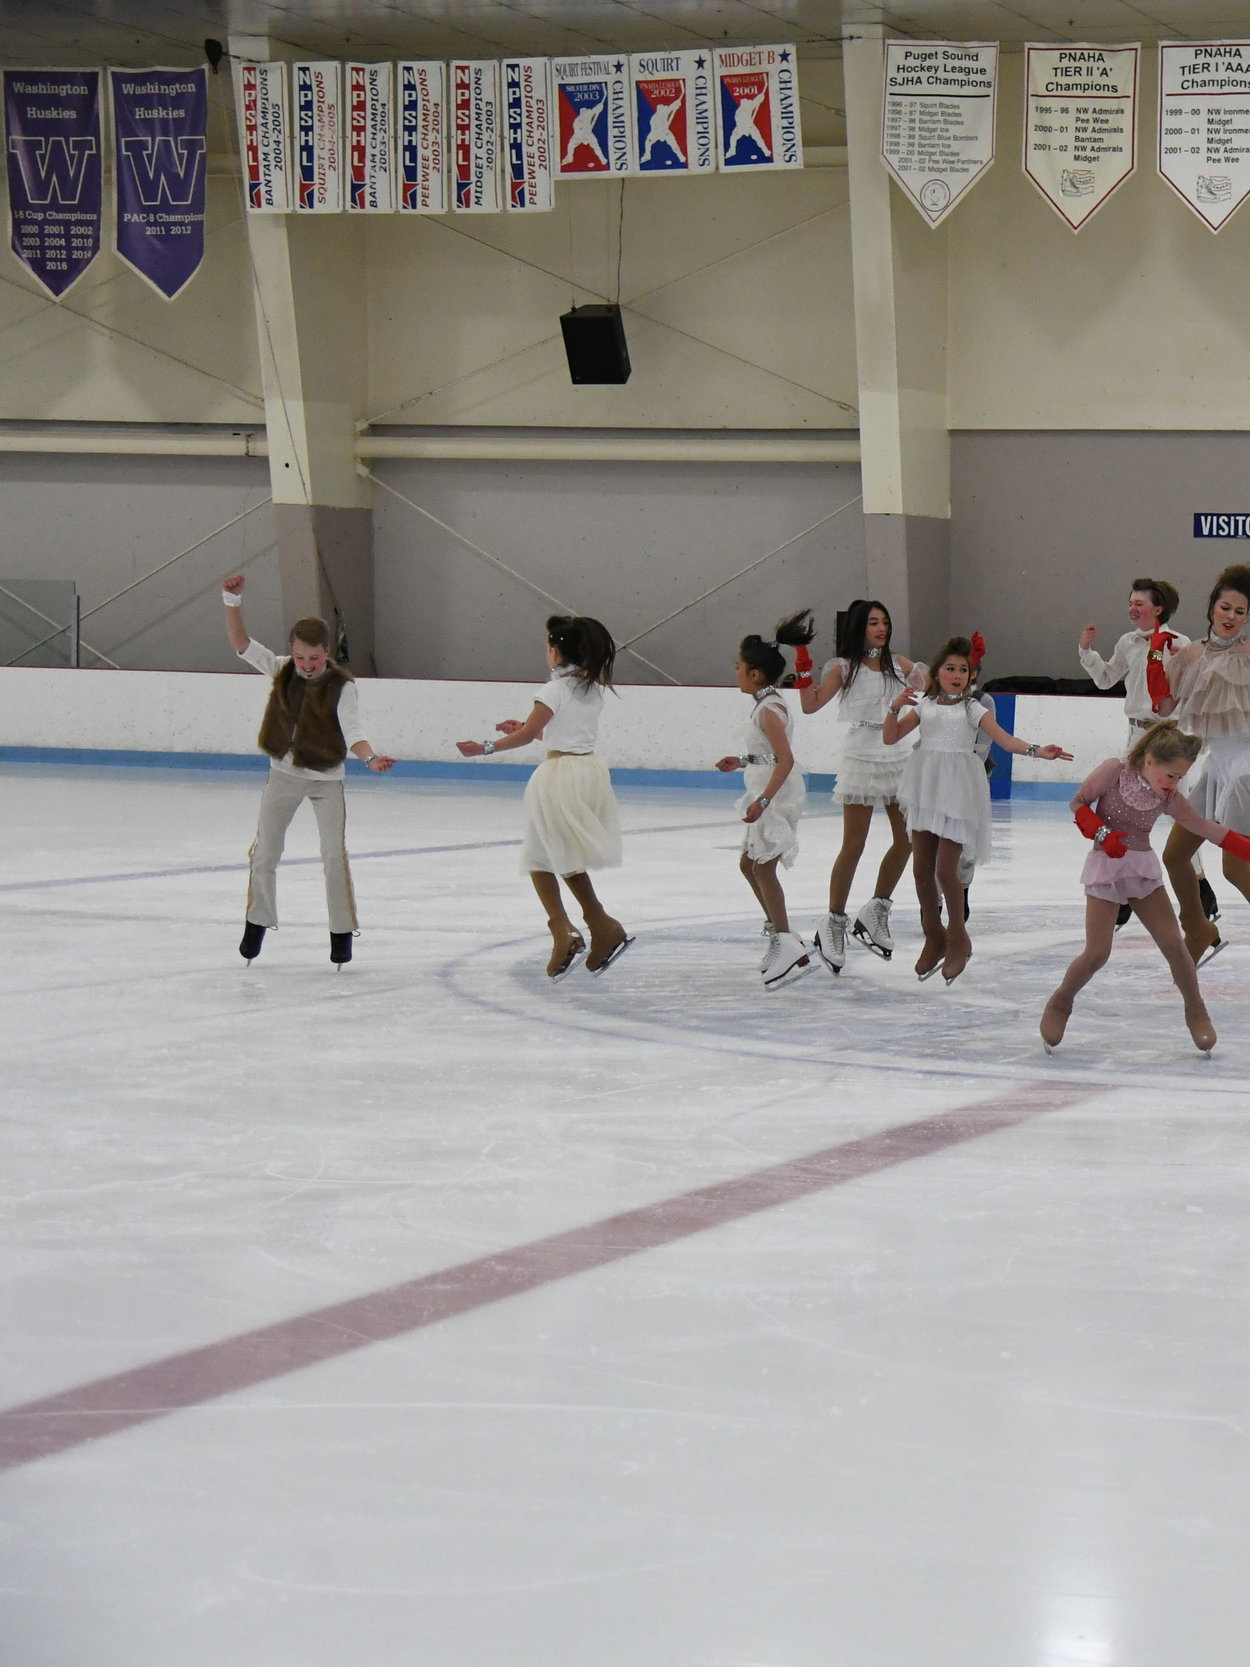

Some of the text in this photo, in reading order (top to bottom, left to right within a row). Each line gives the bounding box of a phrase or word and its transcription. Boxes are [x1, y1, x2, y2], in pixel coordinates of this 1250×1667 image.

[719, 50, 776, 68] MIDGET B
[904, 51, 979, 63] Puget Sound
[1059, 52, 1105, 63] PNAHA
[1194, 48, 1243, 59] PNAHA
[580, 61, 612, 76] FESTIVAL
[638, 56, 681, 76] SQUIRT
[896, 63, 987, 76] Hockey League
[1052, 66, 1083, 78] TIER
[1179, 62, 1211, 76] TIER
[12, 82, 89, 96] Washington
[122, 82, 196, 96] Washington
[889, 75, 992, 89] SJHA Champions
[1045, 81, 1118, 94] Champions
[574, 91, 600, 102] 2003
[651, 88, 676, 98] 2002
[733, 85, 759, 96] 2001
[27, 107, 77, 119] Huskies
[135, 107, 186, 119] Huskies
[299, 70, 314, 166] NPSHL
[352, 70, 366, 166] NPSHL
[403, 70, 417, 166] NPSHL
[456, 69, 470, 165] NPSHL
[507, 67, 522, 164] NPSHL
[778, 69, 797, 163] CHAMPIONS
[1092, 107, 1125, 115] Admirals
[243, 71, 258, 166] NPSHL
[612, 80, 628, 171] CHAMPIONS
[694, 75, 711, 167] CHAMPIONS
[1207, 118, 1233, 127] Midget
[271, 103, 283, 171] 2004-2005
[474, 67, 484, 206] MIDGET CHAMPIONS
[486, 101, 494, 171] 2002-2003
[523, 65, 537, 205] PEEWEE CHAMPIONS
[536, 99, 548, 171] 2002-2003
[1091, 126, 1124, 134] Admirals
[259, 69, 274, 206] BANTAM CHAMPIONS
[368, 69, 379, 208] BANTAM CHAMPIONS
[379, 103, 387, 173] 2003-2004
[418, 68, 431, 207] PEEWEE CHAMPIONS
[432, 103, 440, 173] 2003-2004
[1090, 145, 1123, 153] Admirals
[1073, 155, 1100, 163] Midget
[9, 136, 97, 204] W
[121, 136, 206, 205] W
[317, 154, 328, 204] SQUIRT
[25, 211, 44, 220] Cup
[46, 211, 98, 221] Champions
[156, 213, 205, 223] Champion
[44, 226, 65, 234] 2001
[70, 226, 93, 235] 2002
[145, 226, 192, 235] 2011 2012
[44, 238, 66, 246] 2004
[45, 250, 67, 258] 2012
